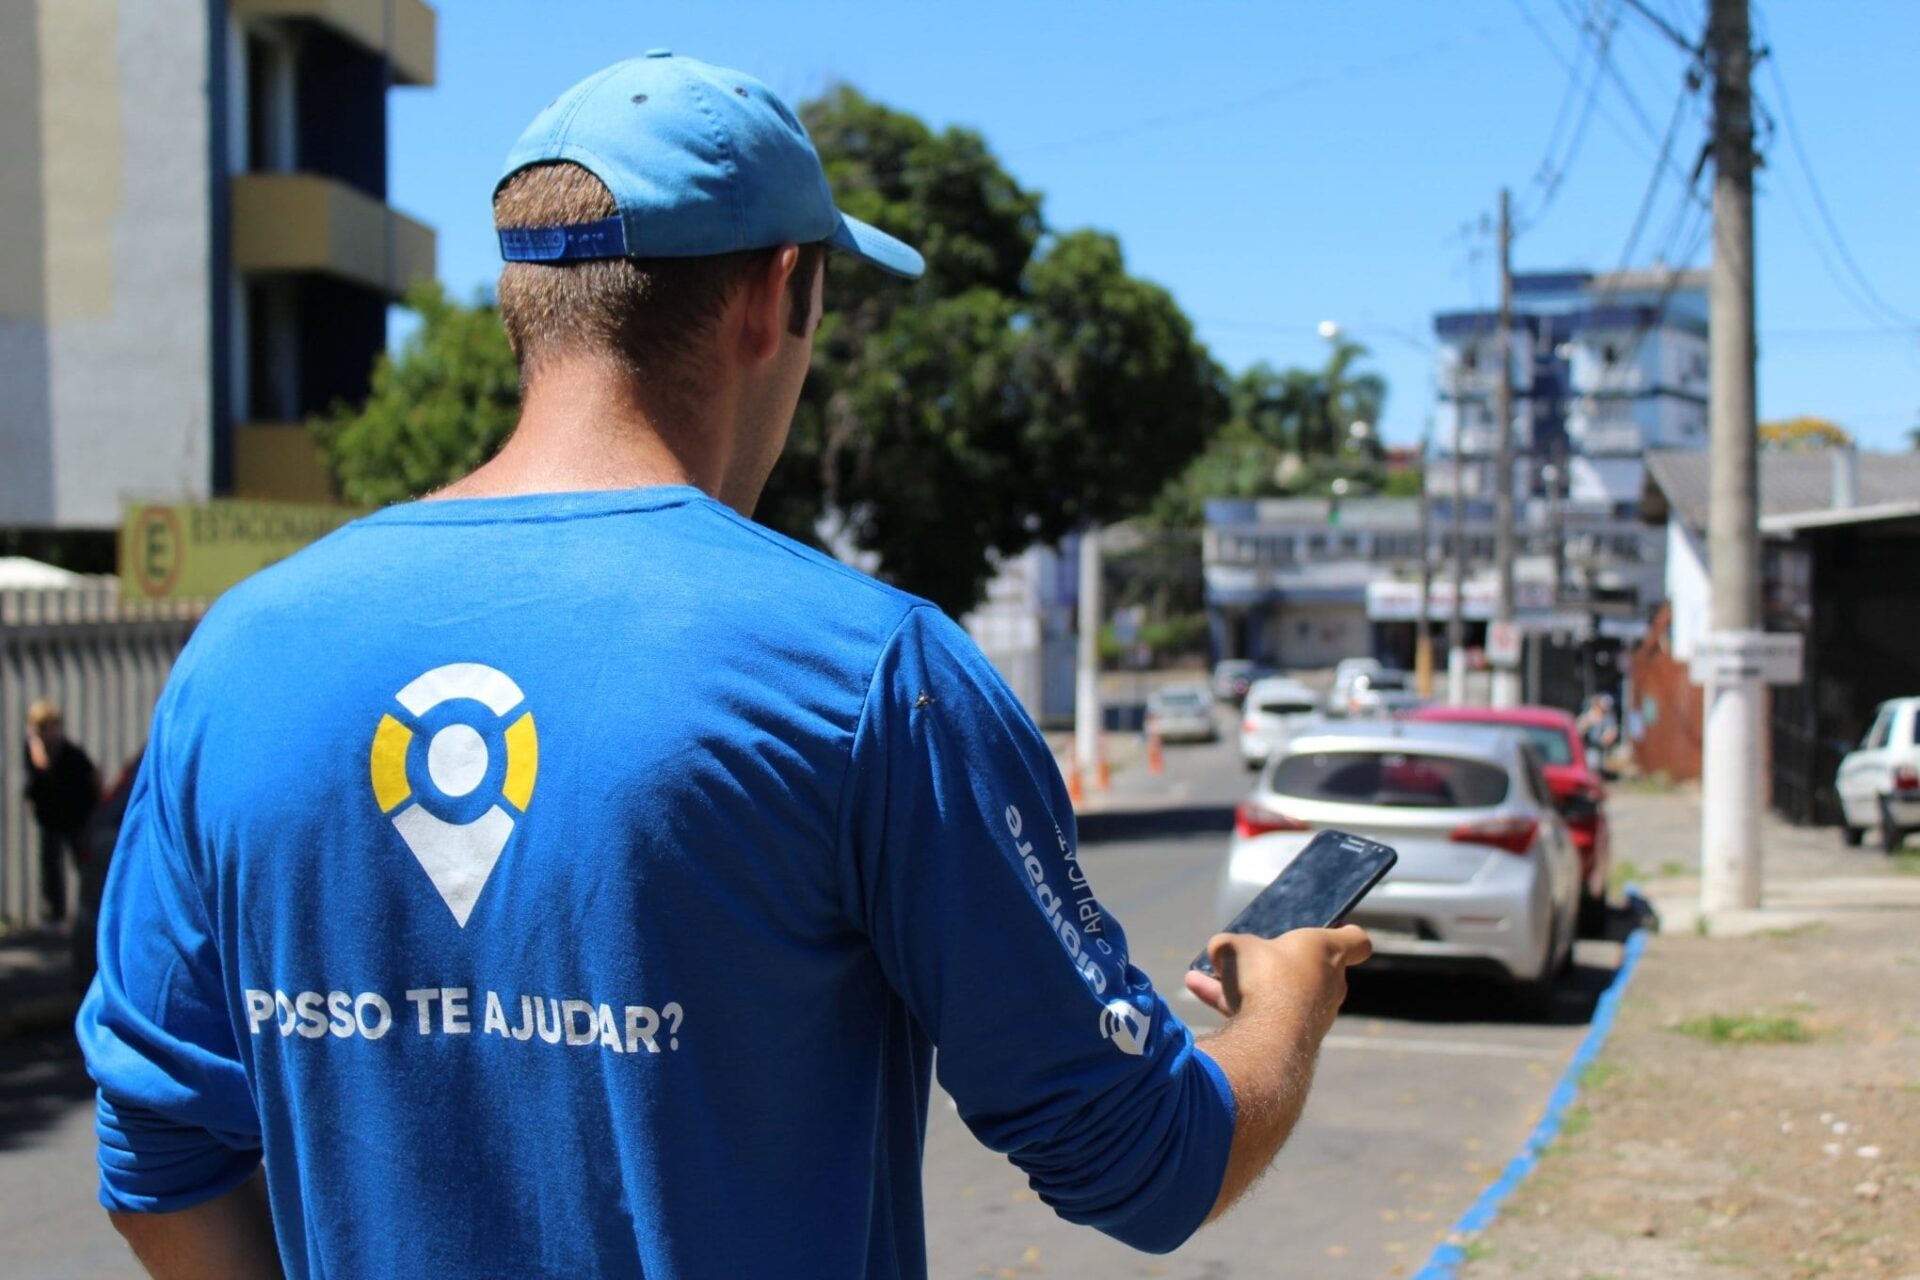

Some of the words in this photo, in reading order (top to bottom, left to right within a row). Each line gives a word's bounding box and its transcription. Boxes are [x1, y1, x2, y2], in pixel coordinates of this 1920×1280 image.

[145, 522, 169, 579] E
[1096, 938, 1112, 955] O
[244, 988, 392, 1040] POSSO
[406, 987, 471, 1036] TE
[483, 991, 684, 1053] AJUDAR?
